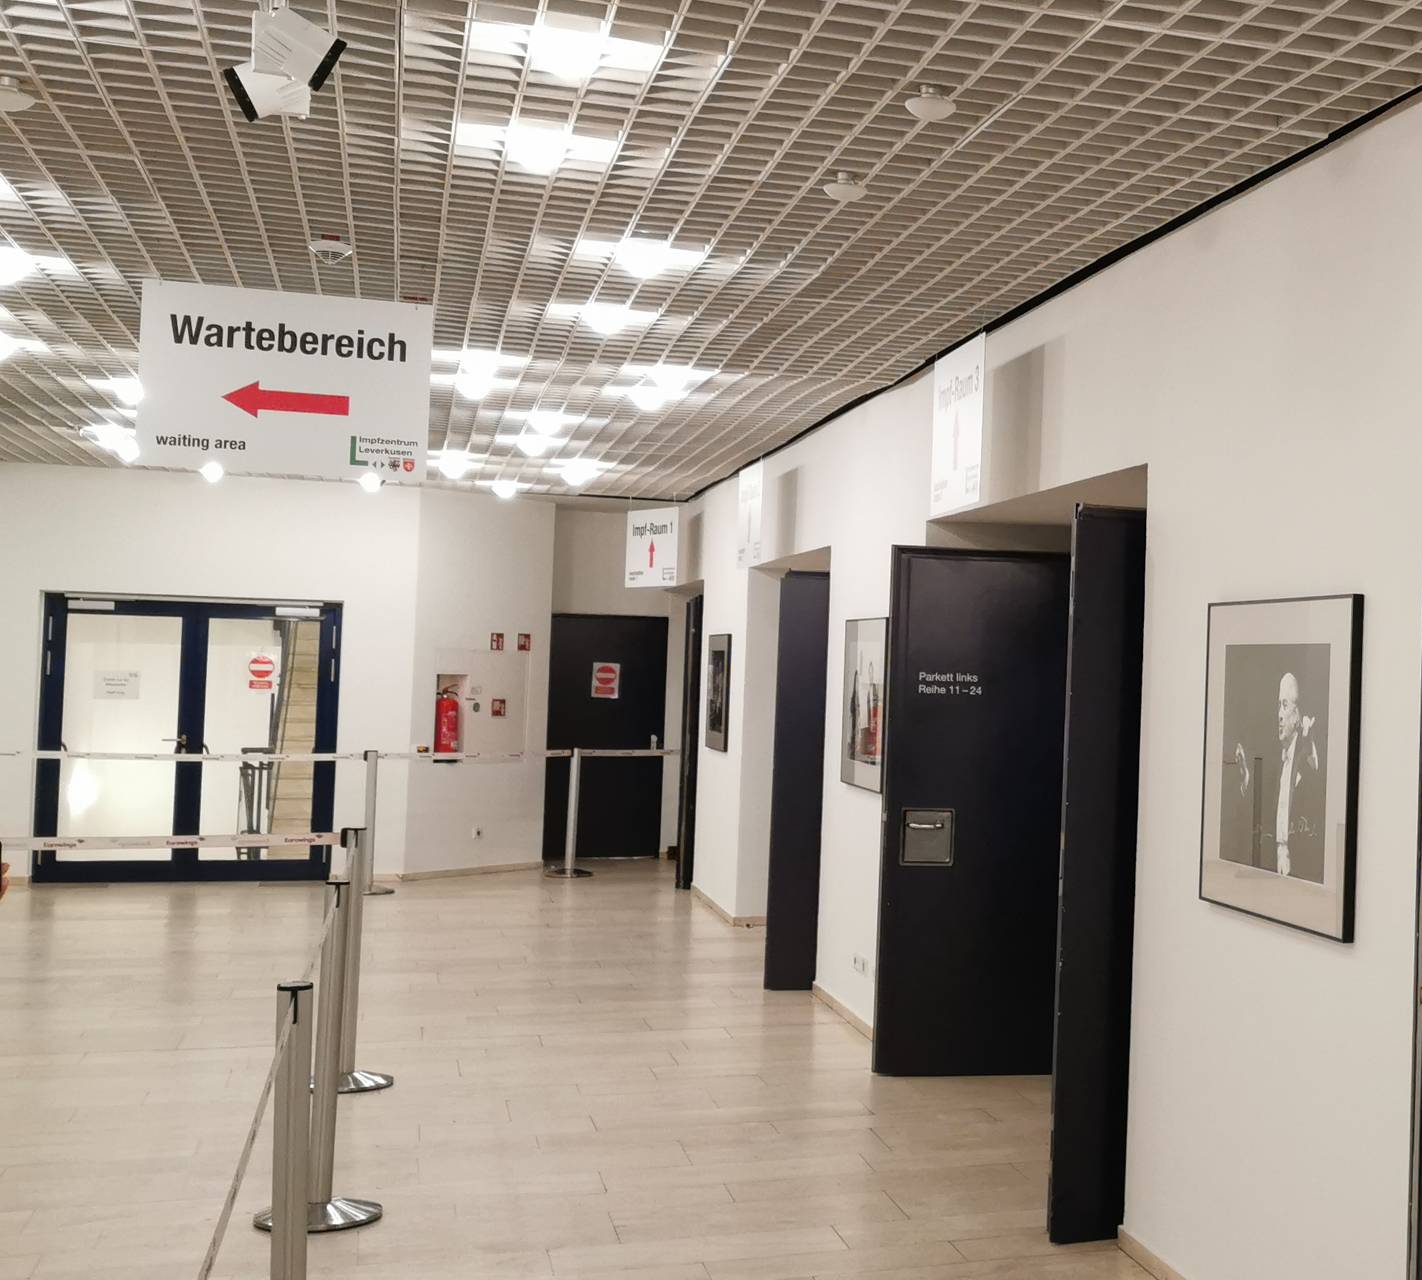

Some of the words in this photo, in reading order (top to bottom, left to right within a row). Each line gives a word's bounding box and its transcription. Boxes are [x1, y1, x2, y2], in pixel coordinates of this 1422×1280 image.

[170, 313, 407, 362] Wartebereich
[156, 433, 209, 451] waiting
[214, 438, 246, 450] area
[359, 436, 418, 447] Impfzentrum
[359, 446, 413, 456] Leverkusen
[632, 522, 668, 539] Impf-Raum
[669, 521, 673, 534] 1
[919, 672, 954, 682] Parkett
[956, 672, 978, 682] links
[918, 684, 947, 694] Reihe
